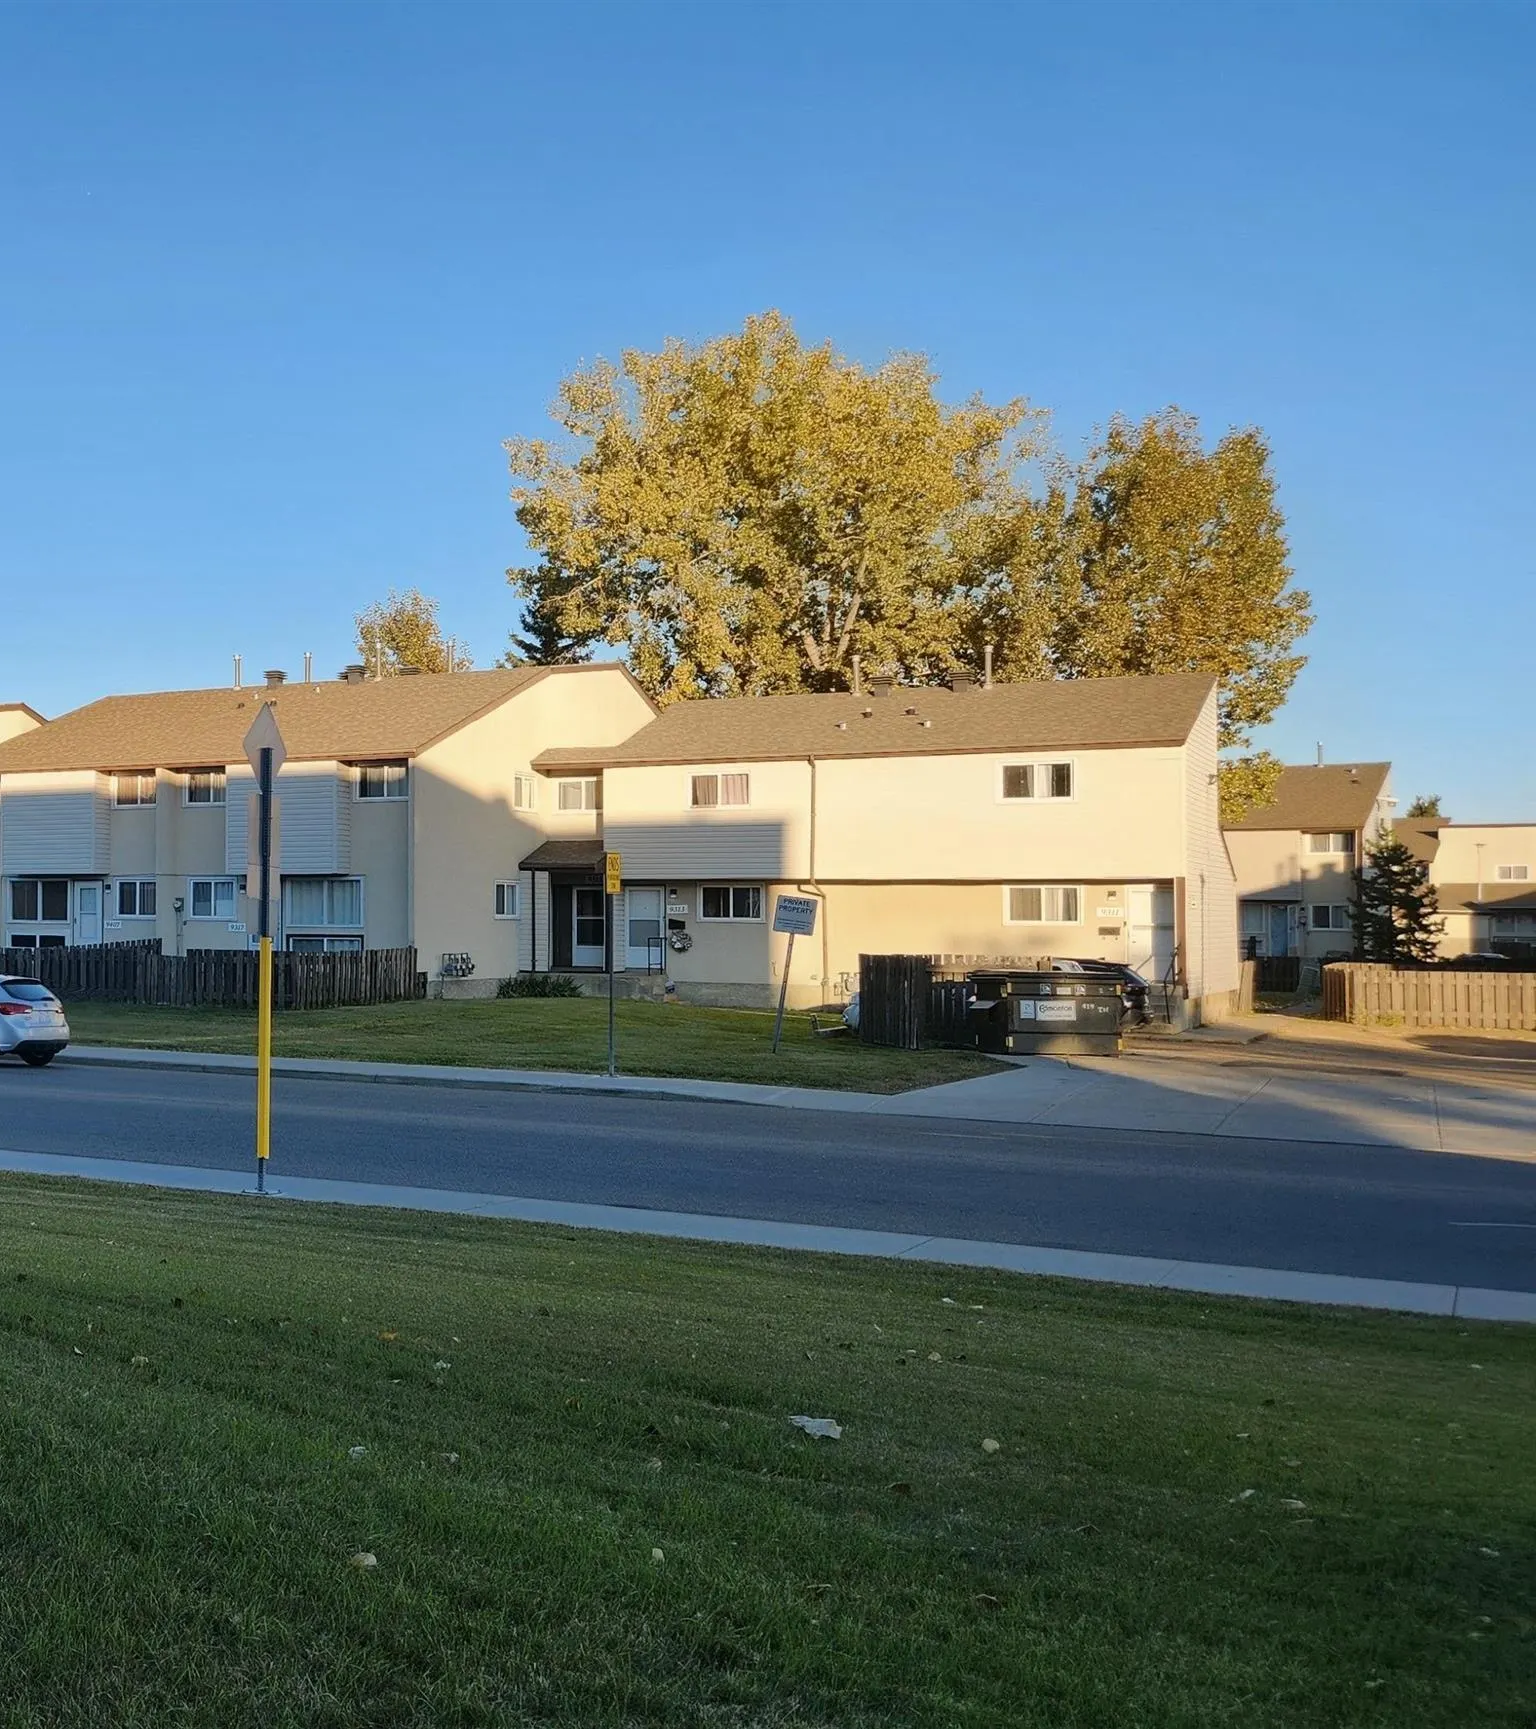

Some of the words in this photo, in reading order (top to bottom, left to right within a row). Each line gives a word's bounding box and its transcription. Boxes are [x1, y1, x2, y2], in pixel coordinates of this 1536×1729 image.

[783, 898, 811, 908] PRIVATE
[778, 904, 813, 914] PROPERTY
[1039, 1004, 1073, 1013] Edmonton
